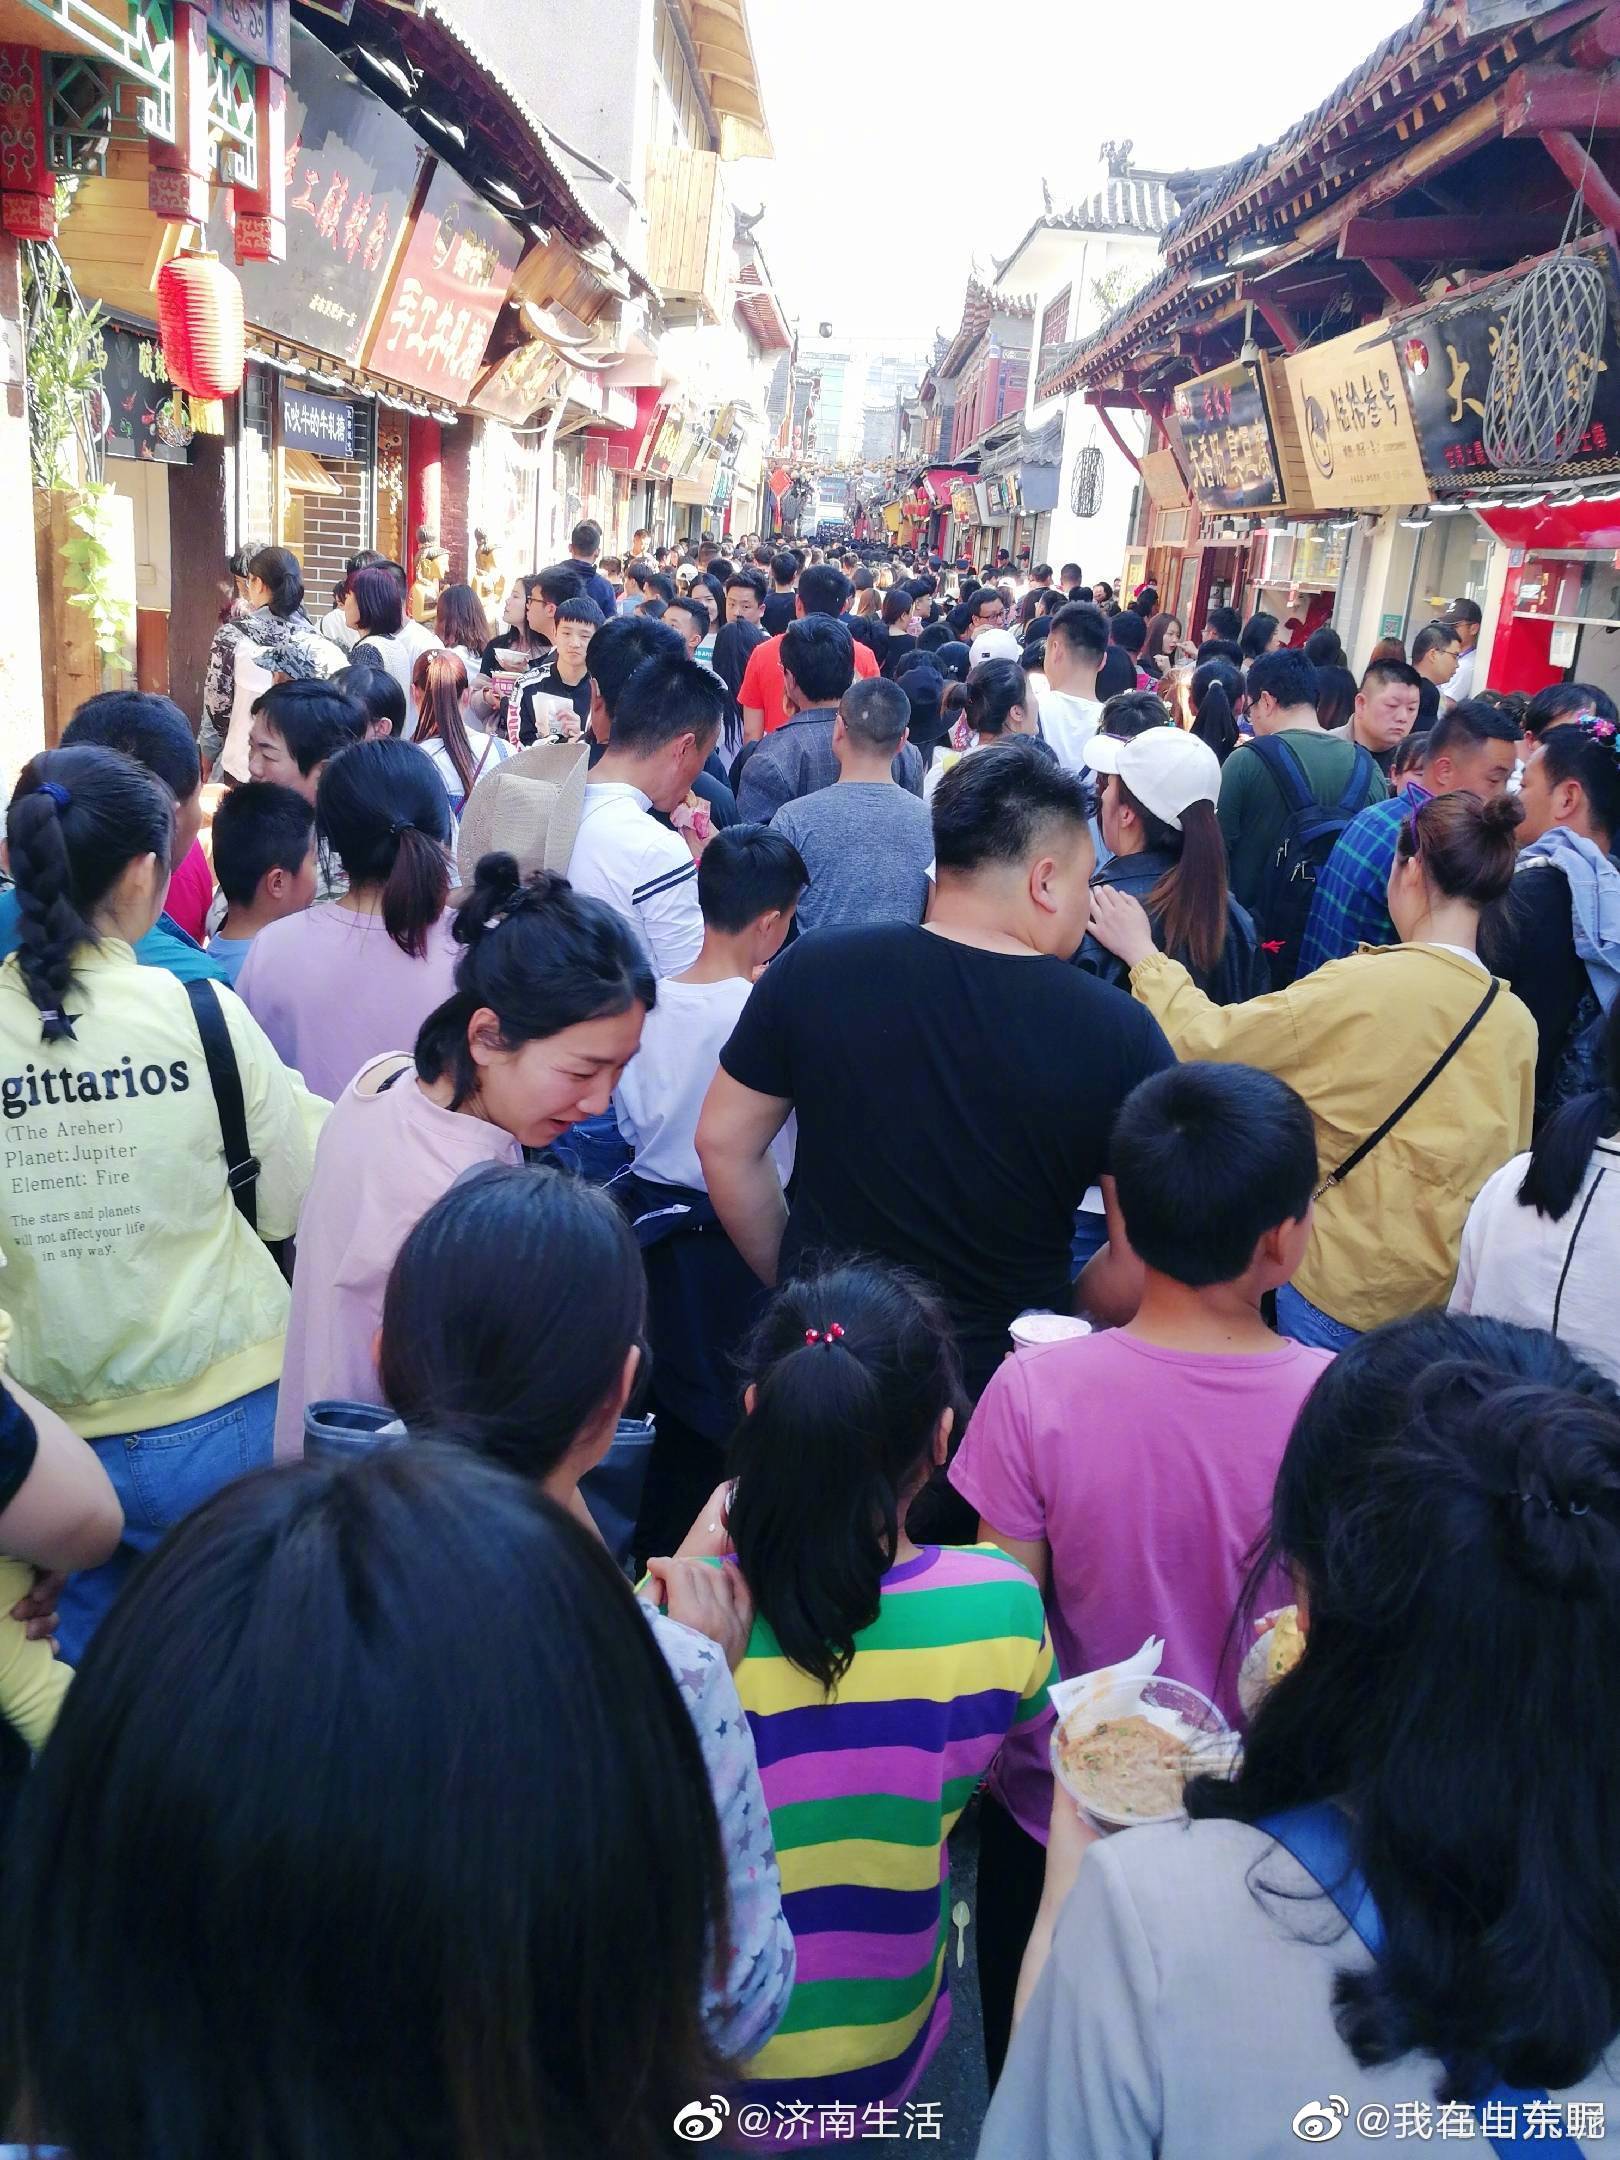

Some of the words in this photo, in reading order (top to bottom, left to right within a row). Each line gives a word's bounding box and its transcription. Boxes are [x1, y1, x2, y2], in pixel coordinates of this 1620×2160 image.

[387, 278, 487, 380] 手工牛轧糖
[284, 402, 346, 442] 不吹牛的牛轧糖
[2, 1056, 190, 1119] gittarios
[5, 1124, 48, 1143] (The
[11, 1174, 87, 1193] Element:
[96, 1169, 130, 1186] Fire
[11, 1214, 35, 1227] The
[40, 1212, 70, 1224] stars
[74, 1207, 94, 1219] and
[98, 1205, 142, 1221] planets
[37, 1233, 57, 1245] not
[126, 1221, 145, 1235] life
[42, 1251, 55, 1261] in
[60, 1247, 83, 1259] any
